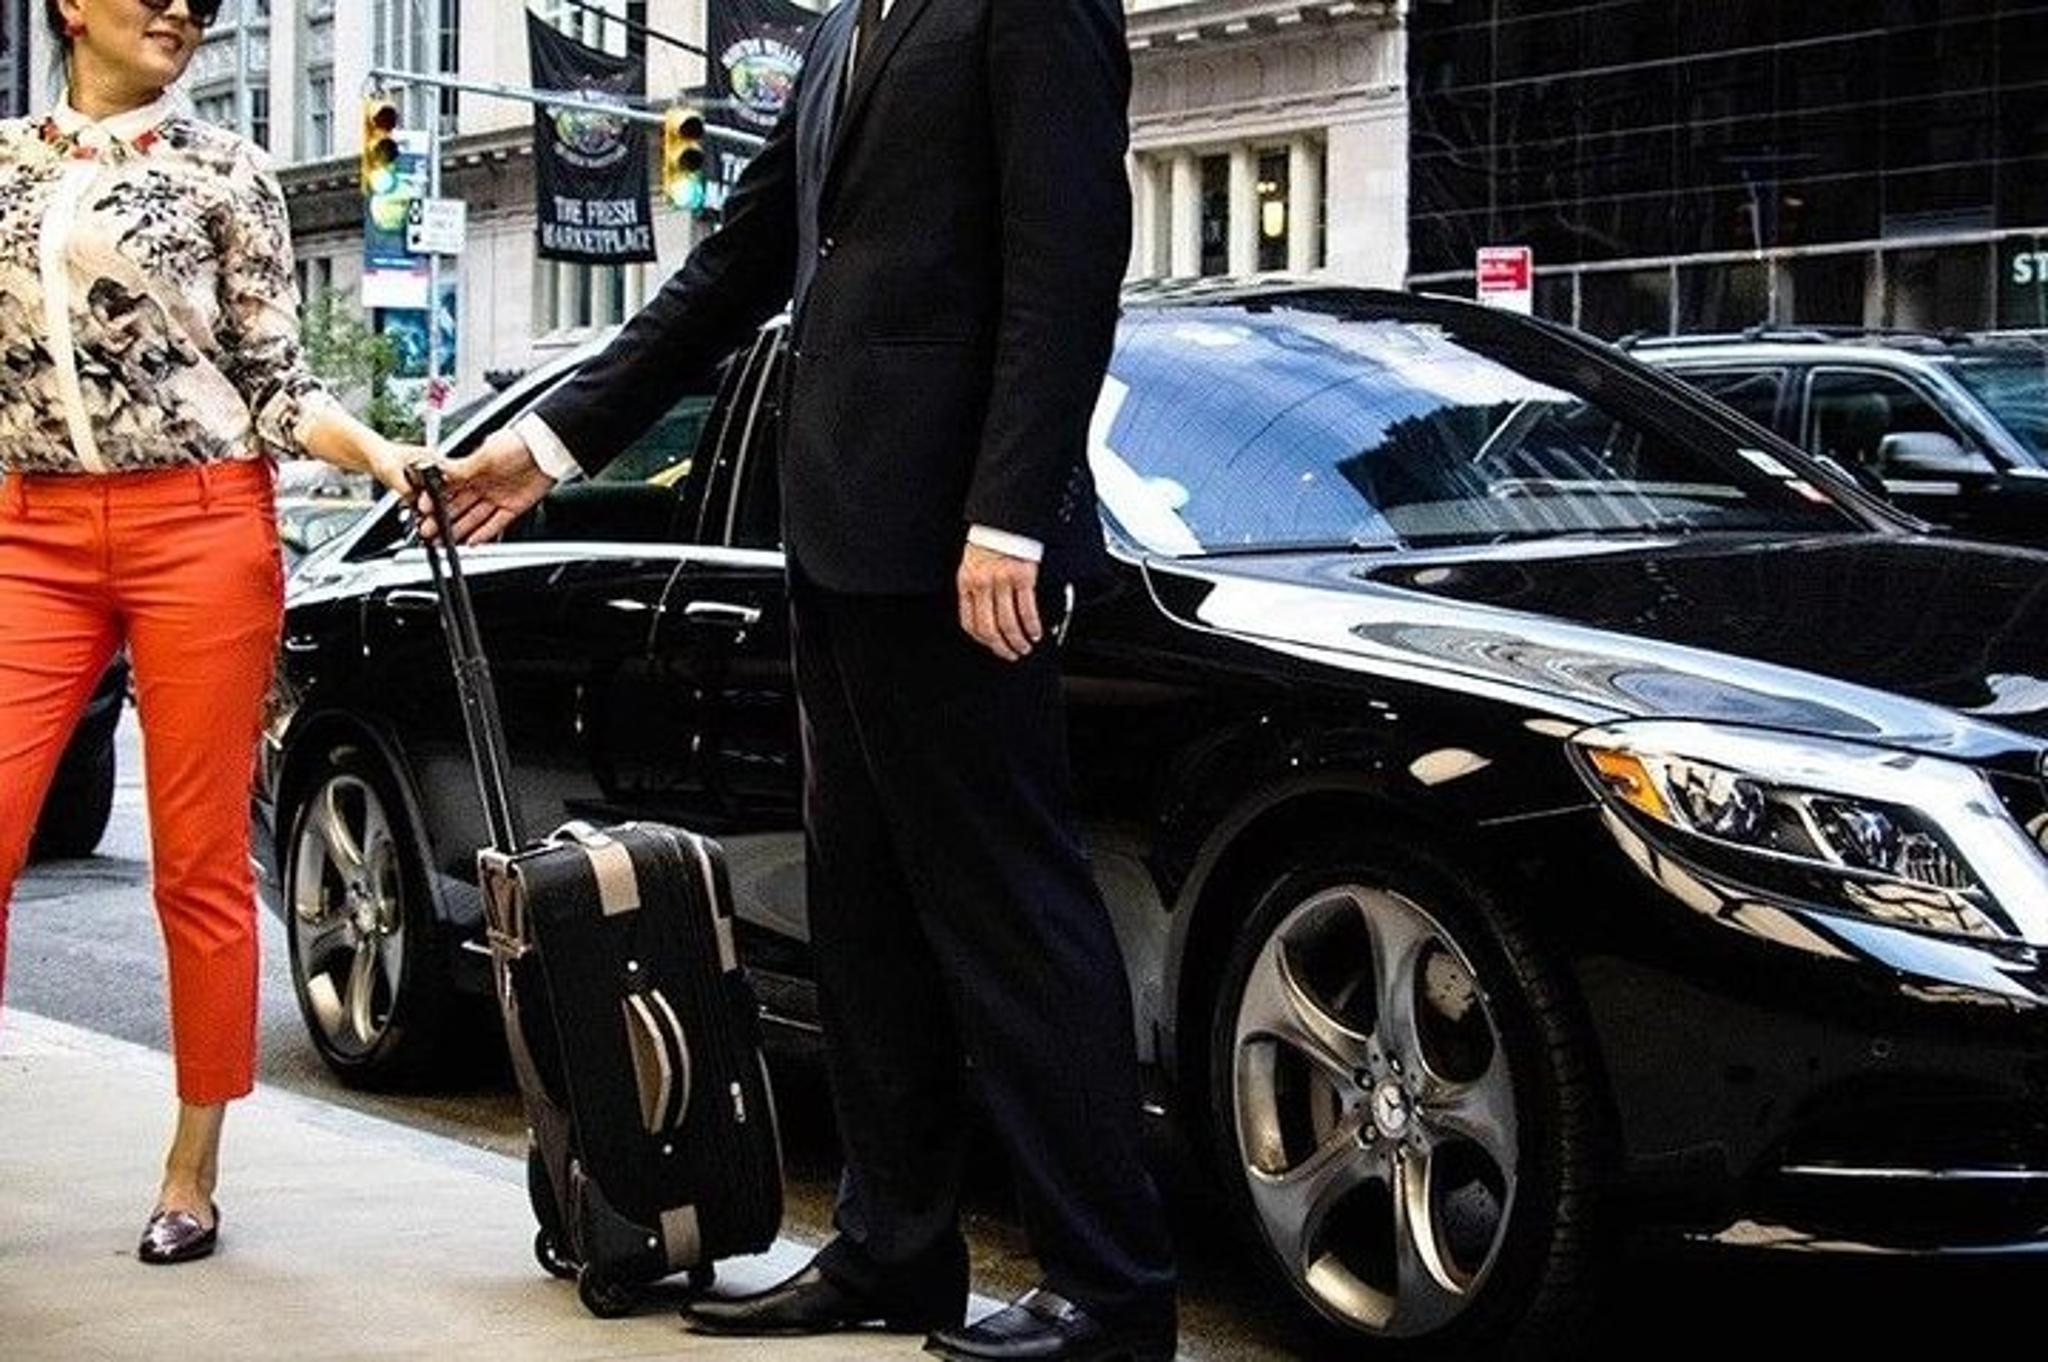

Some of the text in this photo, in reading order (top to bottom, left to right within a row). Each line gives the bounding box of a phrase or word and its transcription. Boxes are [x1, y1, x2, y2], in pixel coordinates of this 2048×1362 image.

[554, 196, 638, 226] THE FRESH
[542, 222, 650, 254] MARKETPLACE
